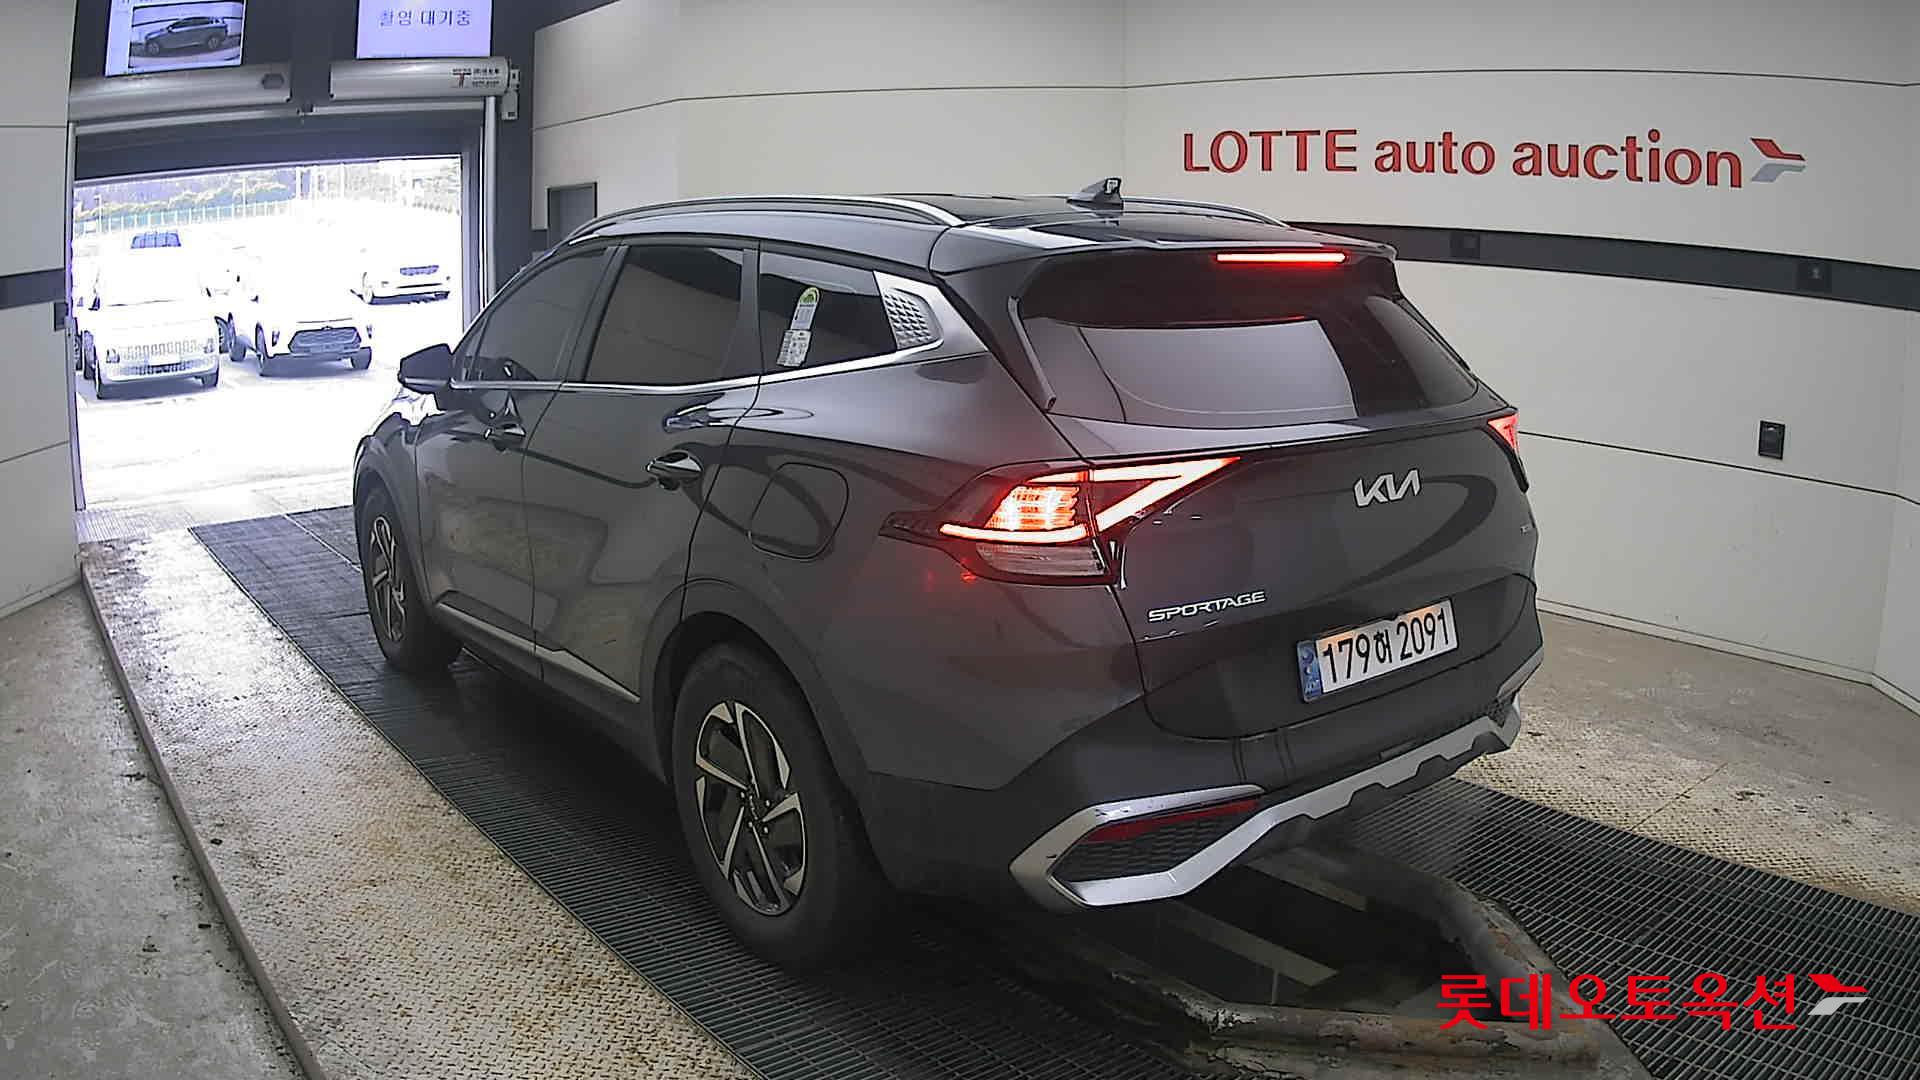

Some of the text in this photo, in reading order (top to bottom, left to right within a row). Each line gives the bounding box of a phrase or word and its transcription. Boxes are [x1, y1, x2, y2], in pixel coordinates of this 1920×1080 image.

[1183, 129, 1743, 188] LOTTE auto auction
[1148, 590, 1266, 622] SPORTAGE
